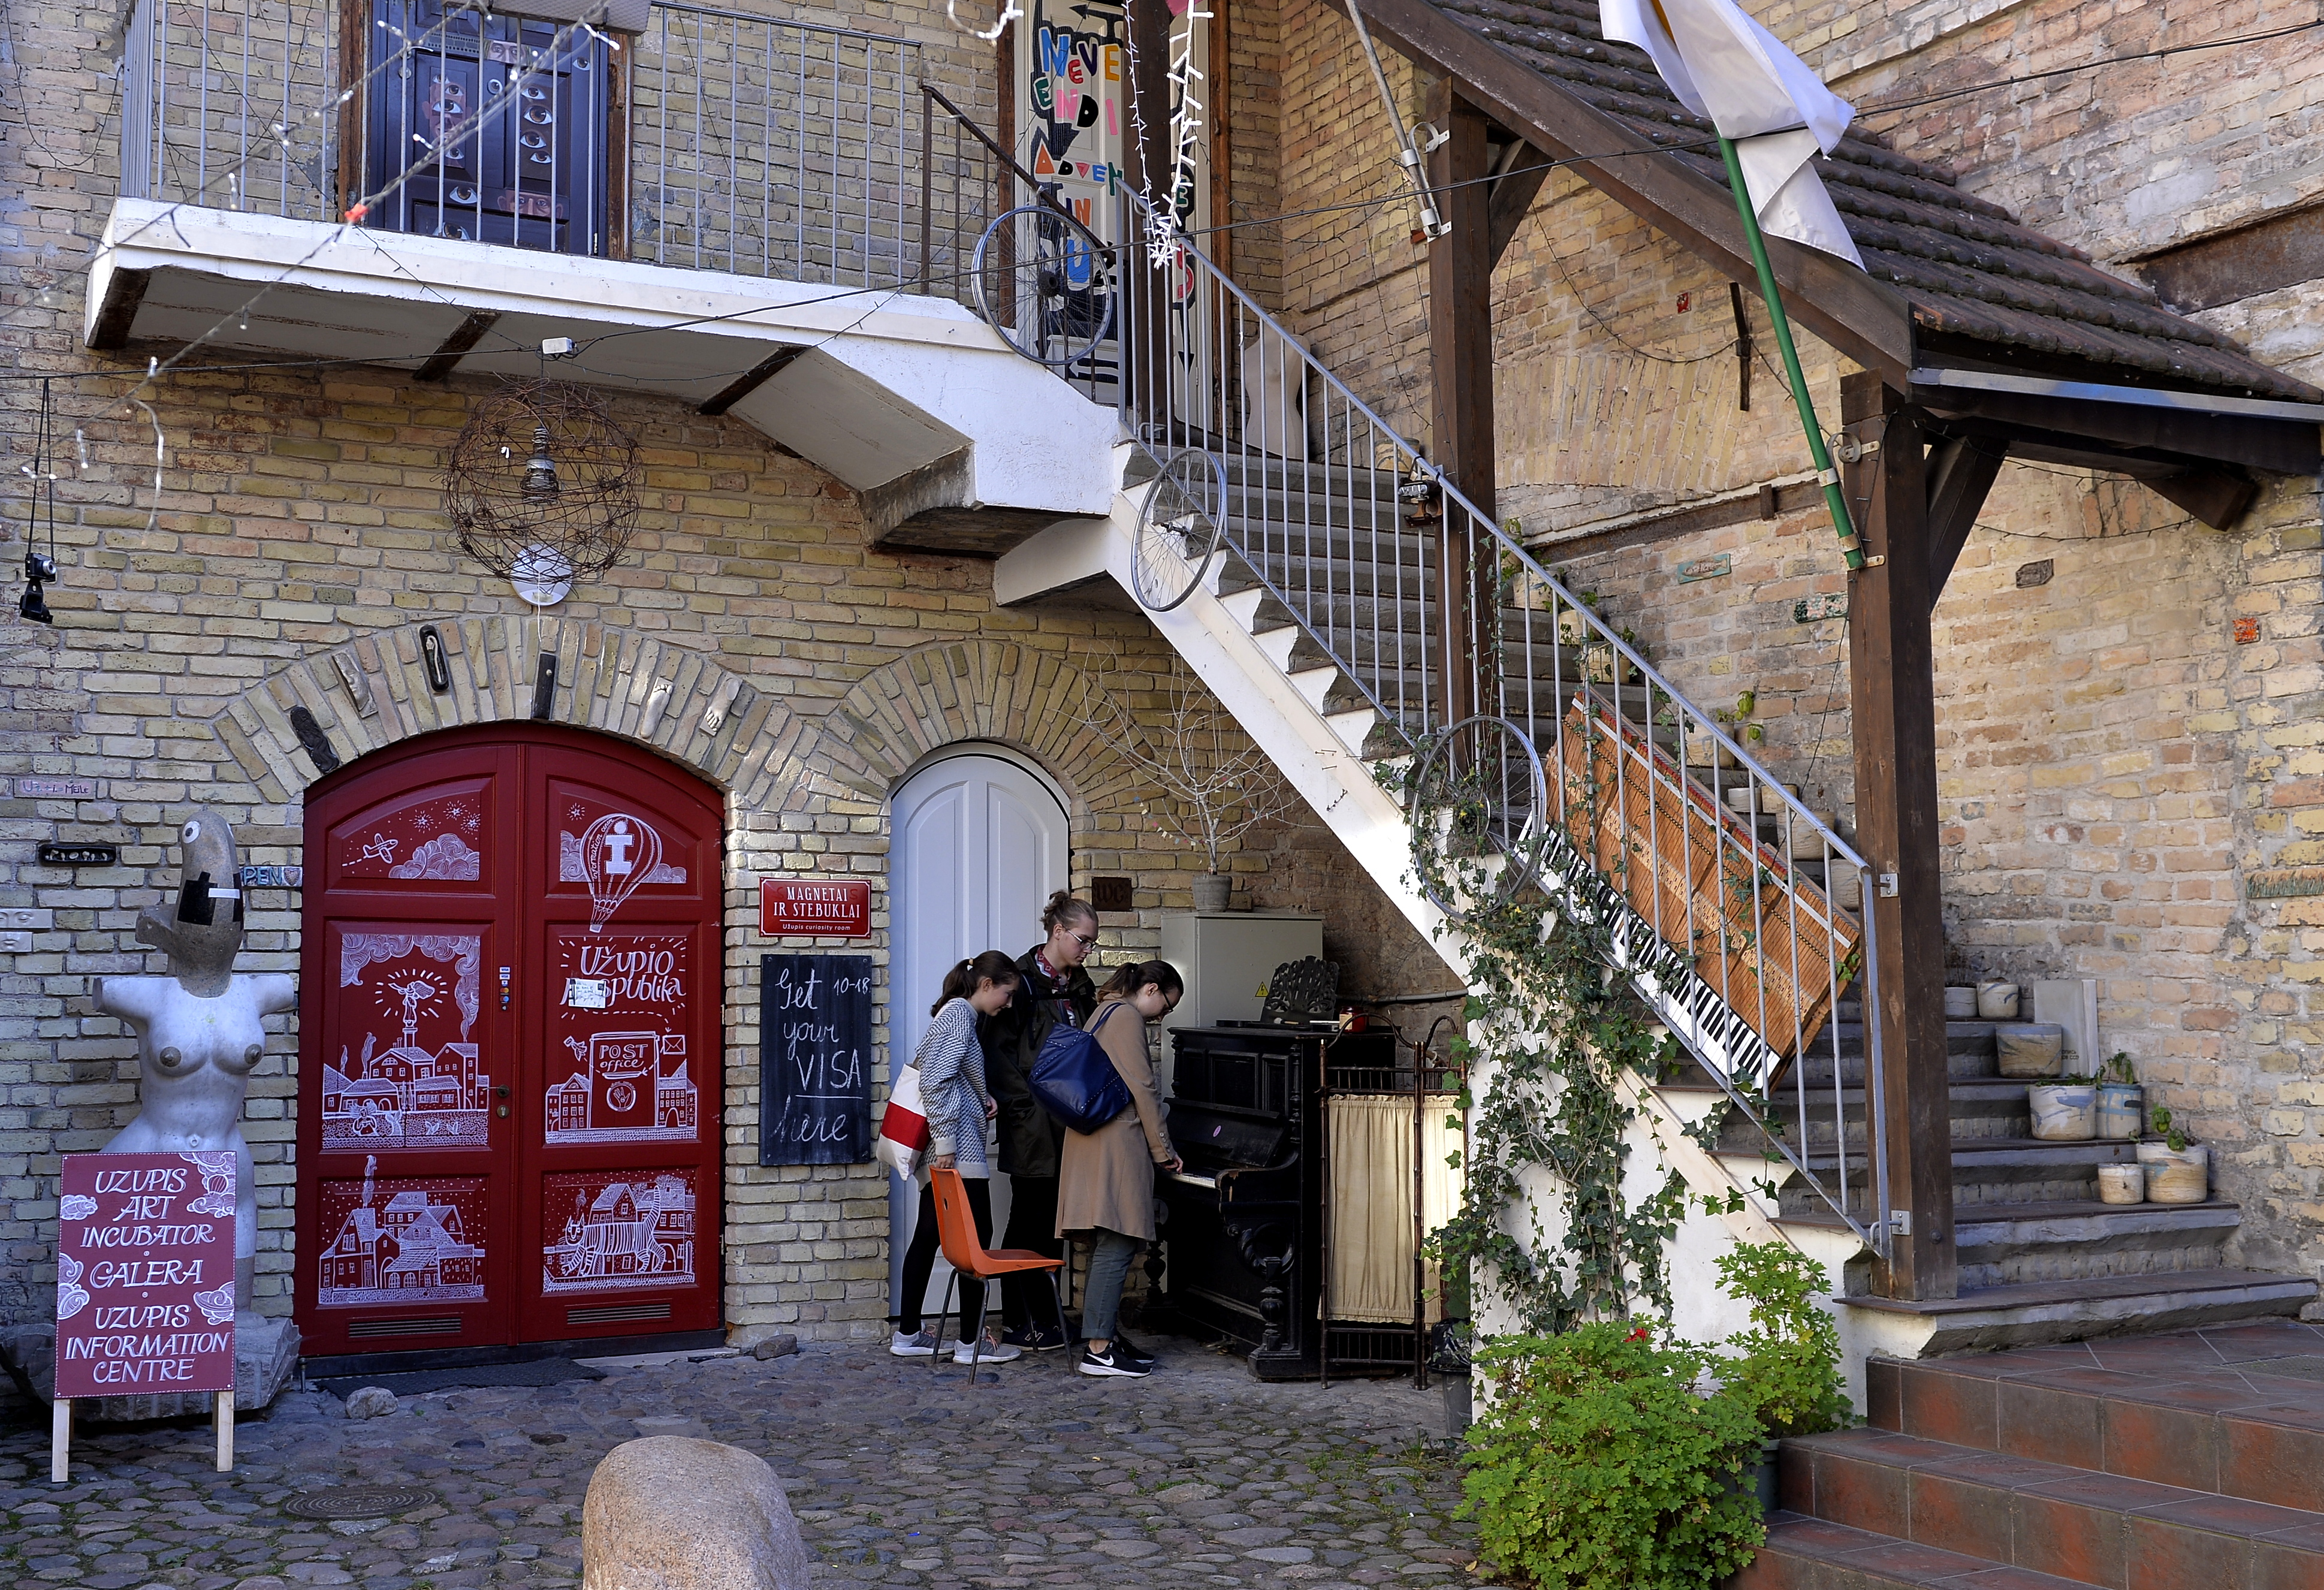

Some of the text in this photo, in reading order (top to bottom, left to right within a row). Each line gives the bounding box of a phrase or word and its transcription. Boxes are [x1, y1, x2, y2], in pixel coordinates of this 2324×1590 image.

[1040, 29, 1120, 84] NEVE
[1034, 79, 1118, 135] ENDI
[242, 867, 282, 885] PEN
[786, 886, 848, 901] MAGNETAI
[773, 902, 860, 918] IR STEBUKLAI
[580, 943, 674, 980] Užupio
[559, 974, 687, 1007] spublika
[775, 968, 871, 1010] Get 10-18
[599, 1044, 648, 1060] POST
[783, 1022, 840, 1061] your
[600, 1059, 644, 1072] office
[796, 1049, 862, 1091] VISA
[769, 1095, 848, 1144] here
[95, 1168, 188, 1194] UZUPIS
[113, 1196, 176, 1221] ART
[80, 1224, 216, 1248] INCUBATOR
[89, 1260, 204, 1289] GALERA
[95, 1305, 191, 1329] UZUPIS
[64, 1332, 231, 1360] INFORMATION
[93, 1358, 196, 1384] CENTRE
